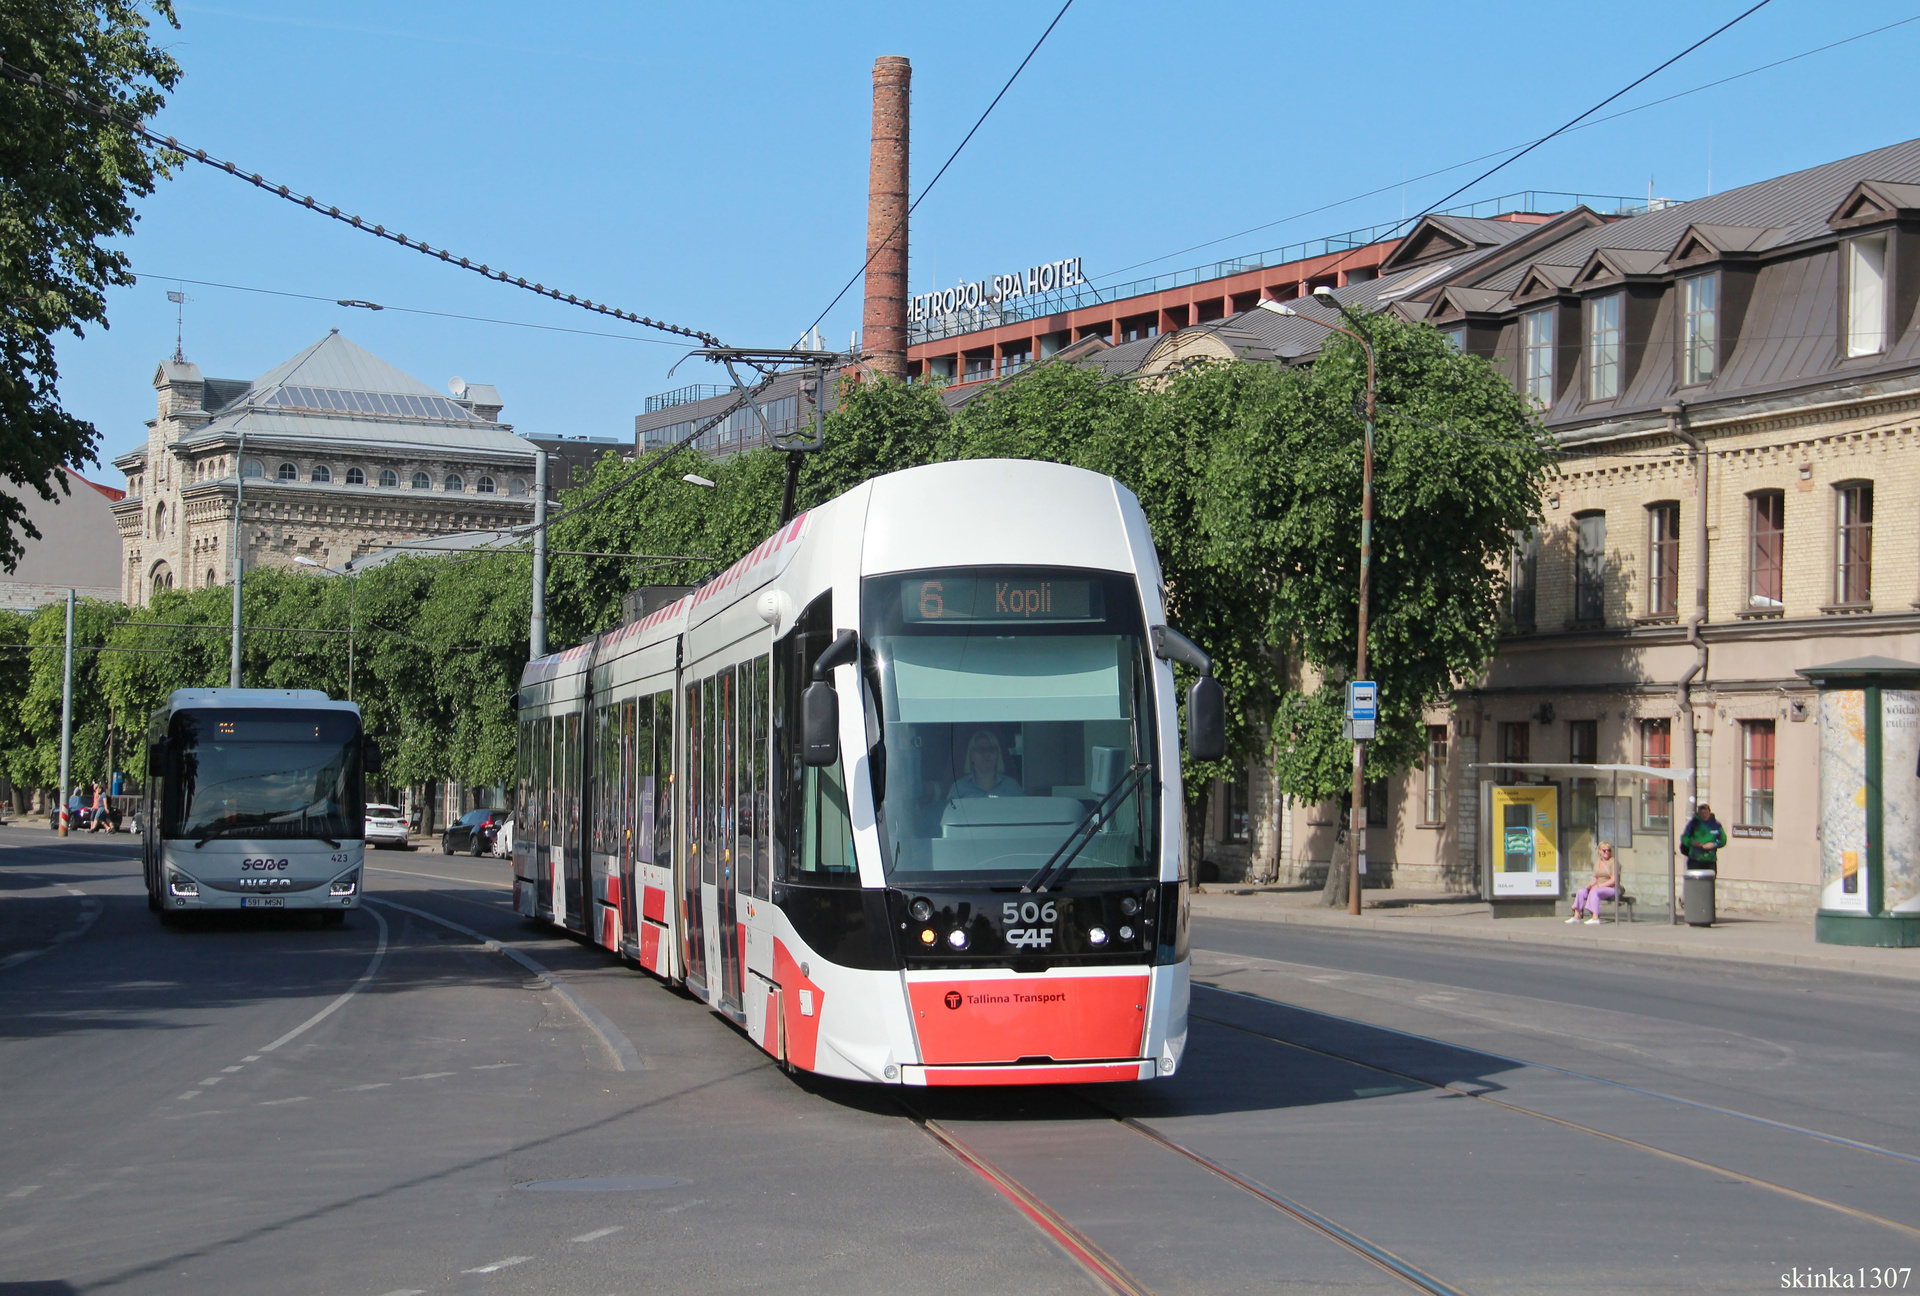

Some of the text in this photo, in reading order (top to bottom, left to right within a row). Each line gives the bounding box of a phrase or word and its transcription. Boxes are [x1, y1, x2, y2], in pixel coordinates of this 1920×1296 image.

[907, 257, 1084, 322] METROPOL SPA HOTEL
[920, 581, 1050, 618] 6 Kopli
[331, 854, 348, 862] 423
[239, 878, 291, 888] IVECO
[1002, 901, 1058, 924] 506
[1005, 928, 1053, 948] CAF
[967, 992, 1066, 1004] Tallinna Transport
